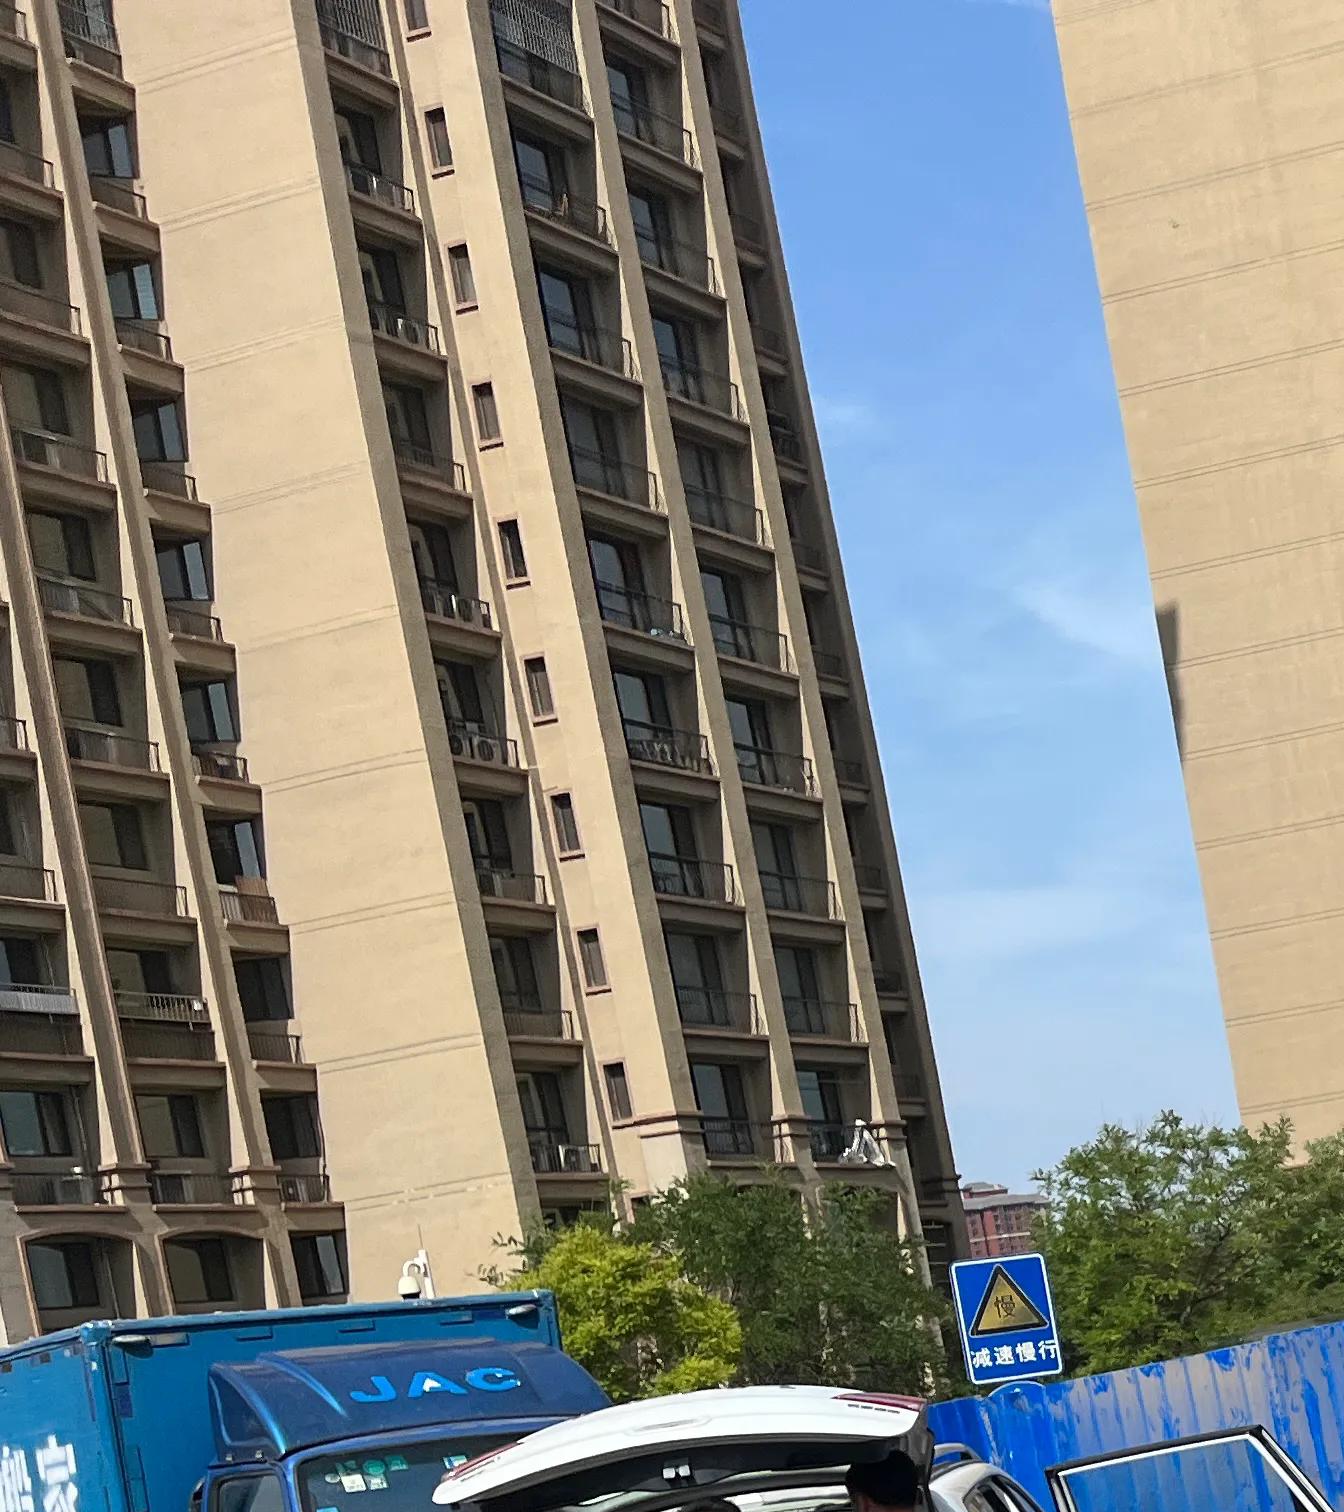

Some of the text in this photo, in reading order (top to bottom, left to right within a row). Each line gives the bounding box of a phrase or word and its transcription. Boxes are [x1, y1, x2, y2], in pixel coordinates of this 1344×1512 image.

[970, 1339, 1057, 1369] 减速慢行
[349, 1366, 521, 1403] JAC
